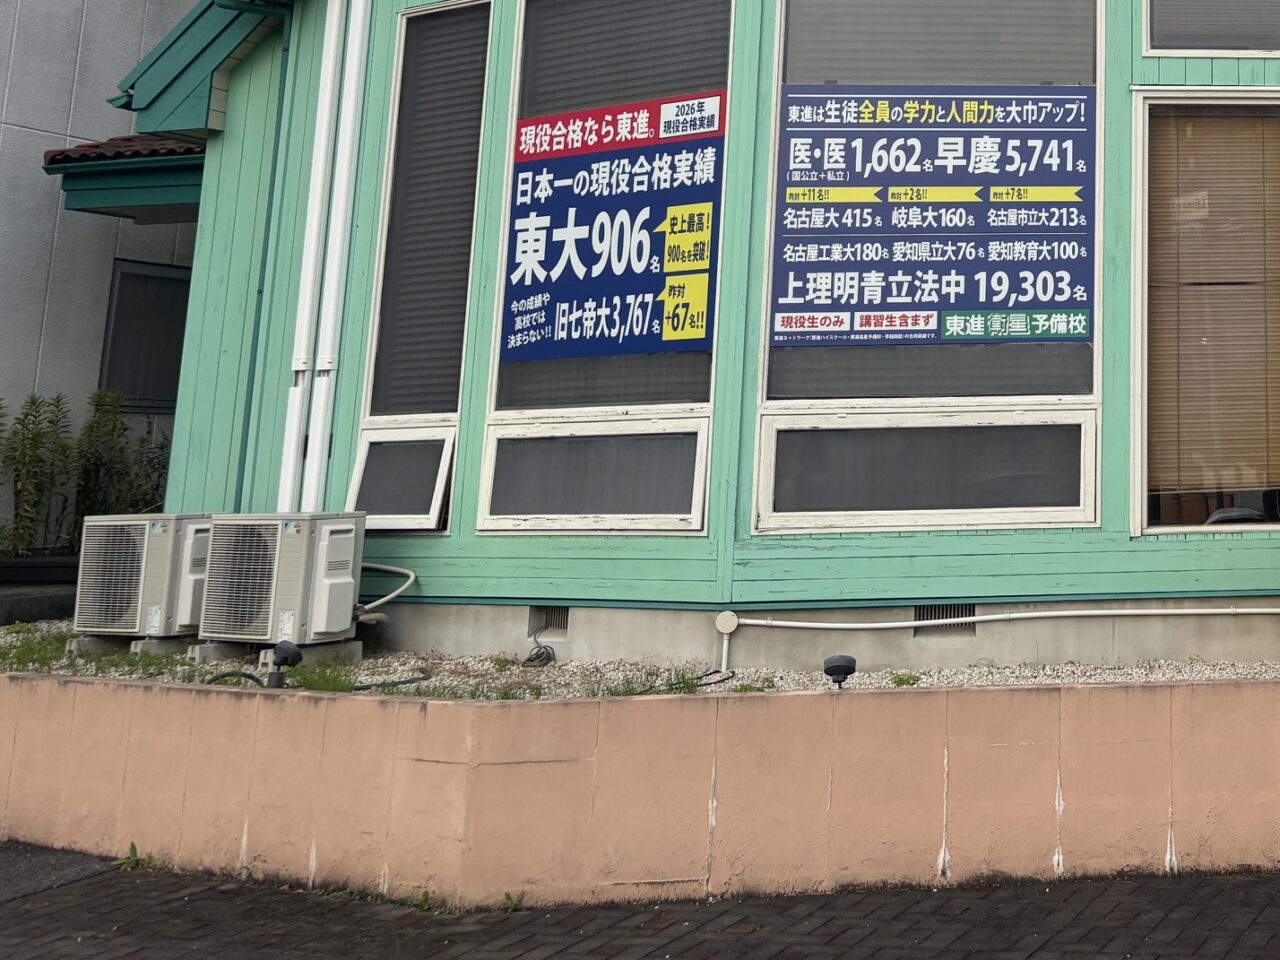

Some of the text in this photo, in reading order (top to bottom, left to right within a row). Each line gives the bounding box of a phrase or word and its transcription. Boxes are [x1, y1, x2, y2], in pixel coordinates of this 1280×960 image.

[675, 101, 705, 117] 2026年
[519, 109, 654, 154] 現役合格なら東進。
[663, 114, 715, 134] 現役合格実績
[515, 146, 716, 206] 日本一の現役合格実績
[510, 292, 551, 314] 今の成績や
[514, 310, 546, 330] 高校では
[780, 315, 845, 329] 現役生のみ
[859, 313, 934, 328] 講習生含まず
[945, 313, 1086, 336] 東進衛星予備校
